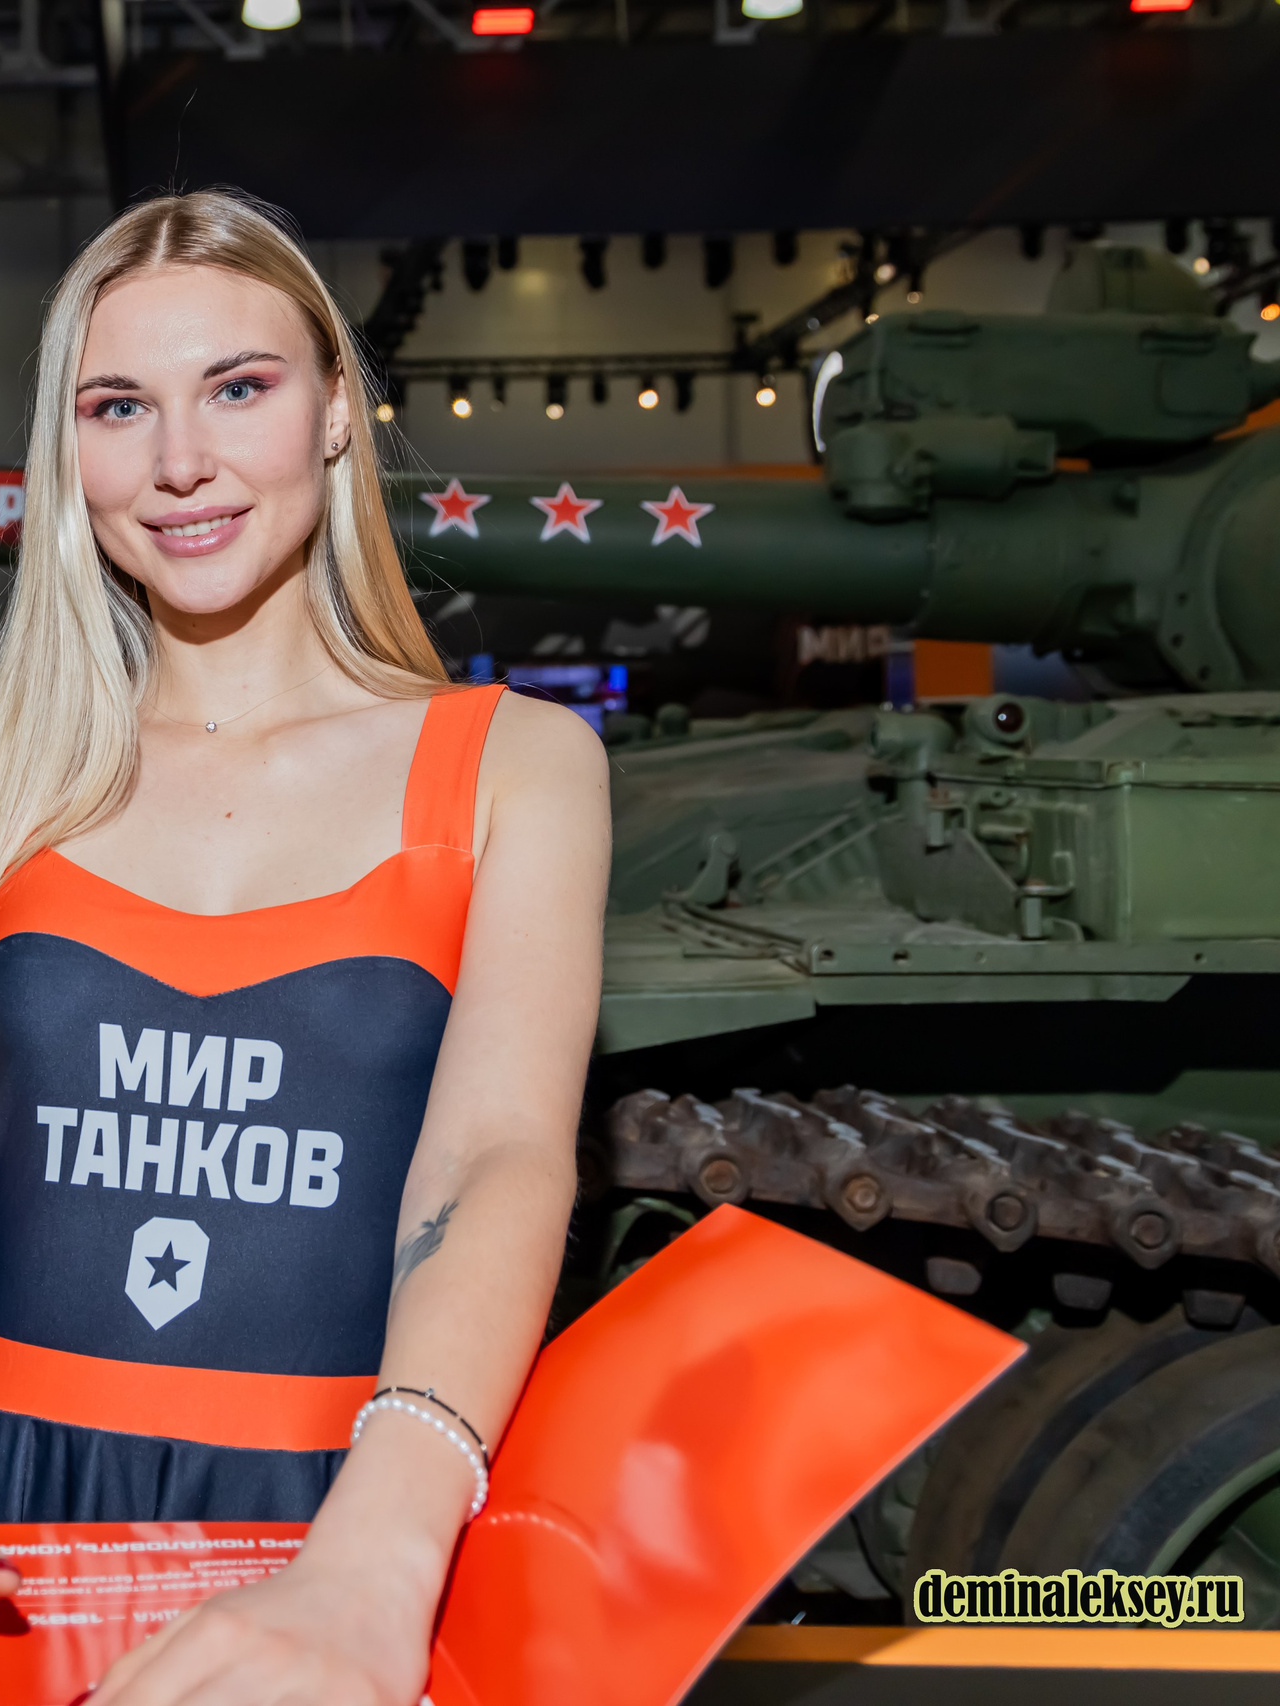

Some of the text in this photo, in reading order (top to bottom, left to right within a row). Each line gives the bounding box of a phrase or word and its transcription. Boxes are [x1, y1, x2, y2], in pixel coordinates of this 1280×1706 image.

[798, 626, 890, 664] МИР
[99, 1022, 284, 1112] МИР
[37, 1105, 344, 1208] ТАНКОВ
[74, 1538, 256, 1553] ПОЖАЛОВАТЬ,
[96, 1583, 159, 1594] история
[27, 1612, 104, 1625] 100%
